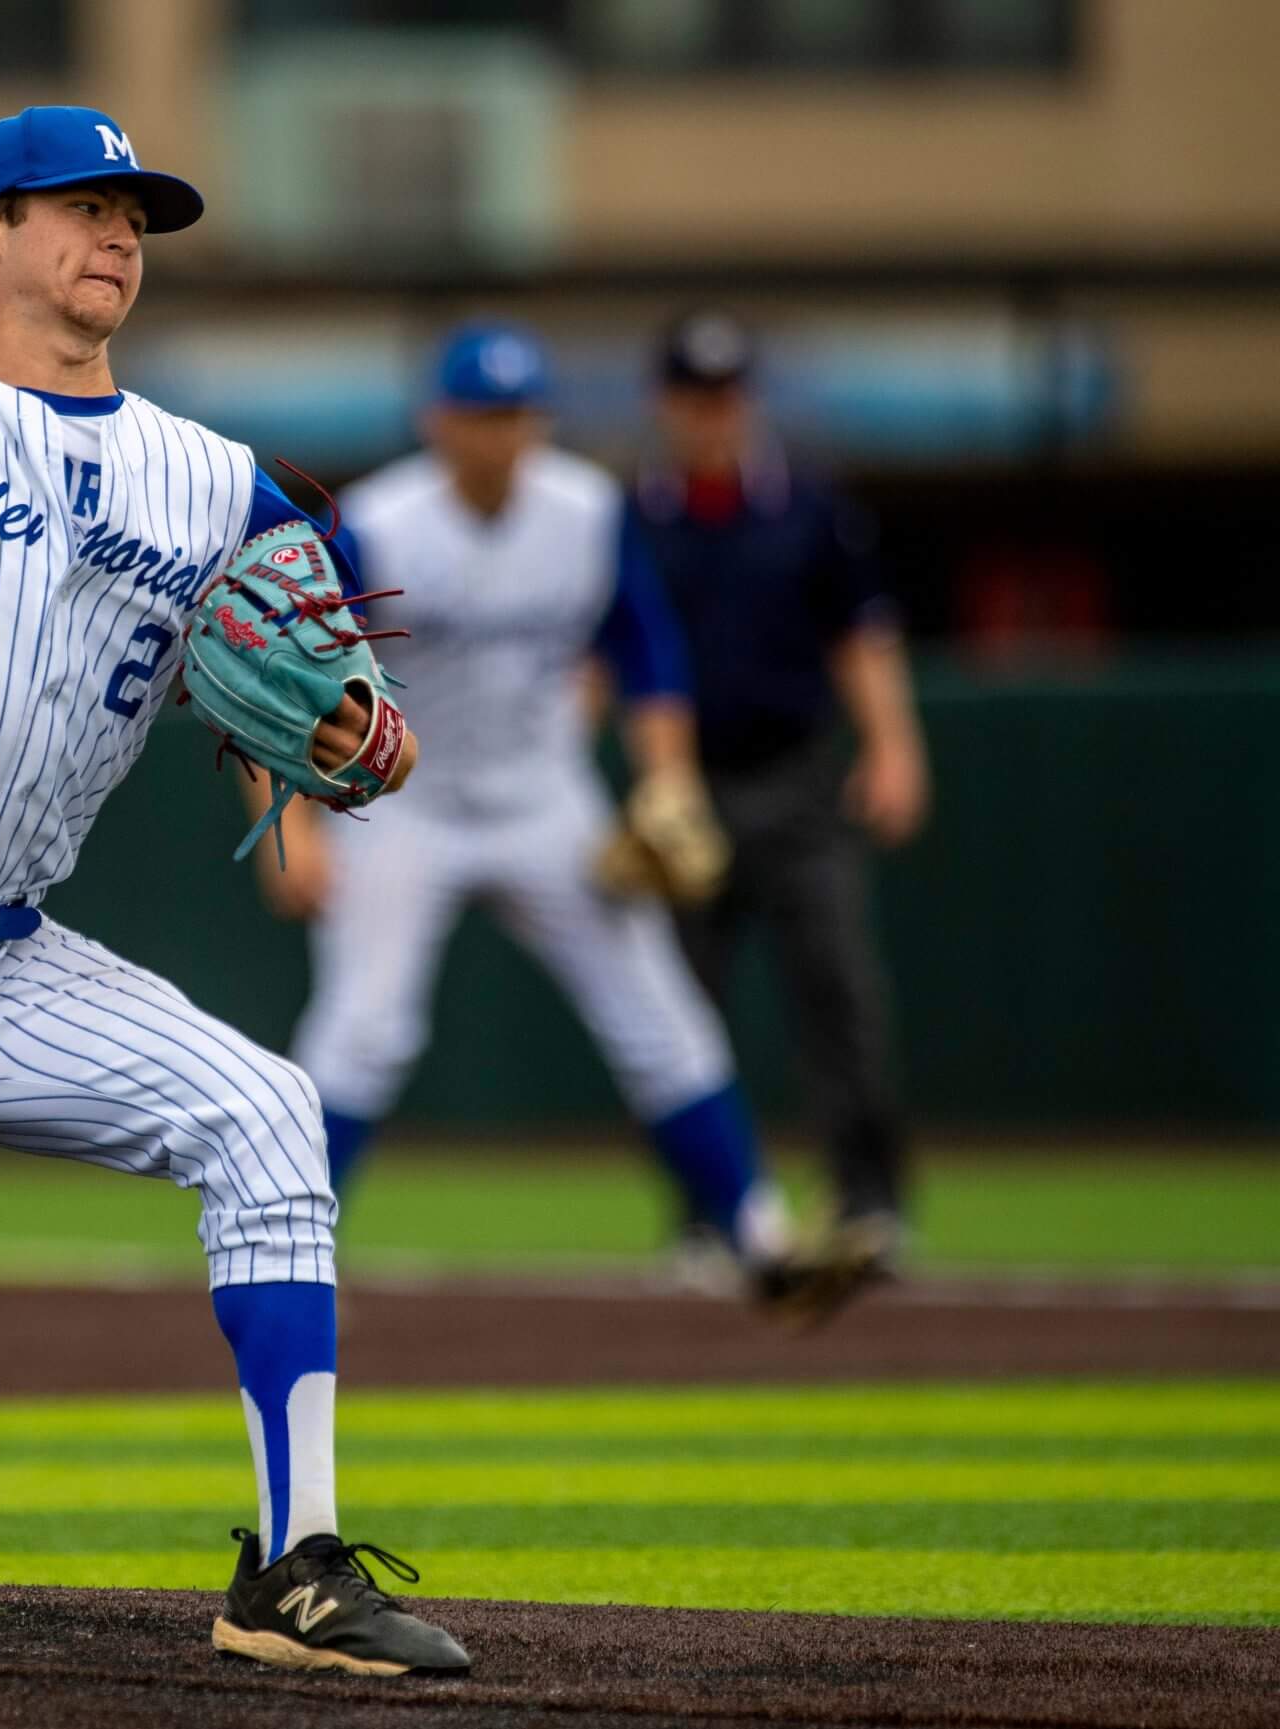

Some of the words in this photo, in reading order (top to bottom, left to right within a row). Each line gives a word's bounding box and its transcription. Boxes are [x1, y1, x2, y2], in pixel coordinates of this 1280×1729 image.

[94, 124, 139, 170] M
[103, 622, 172, 720] 2
[276, 1583, 339, 1634] N
